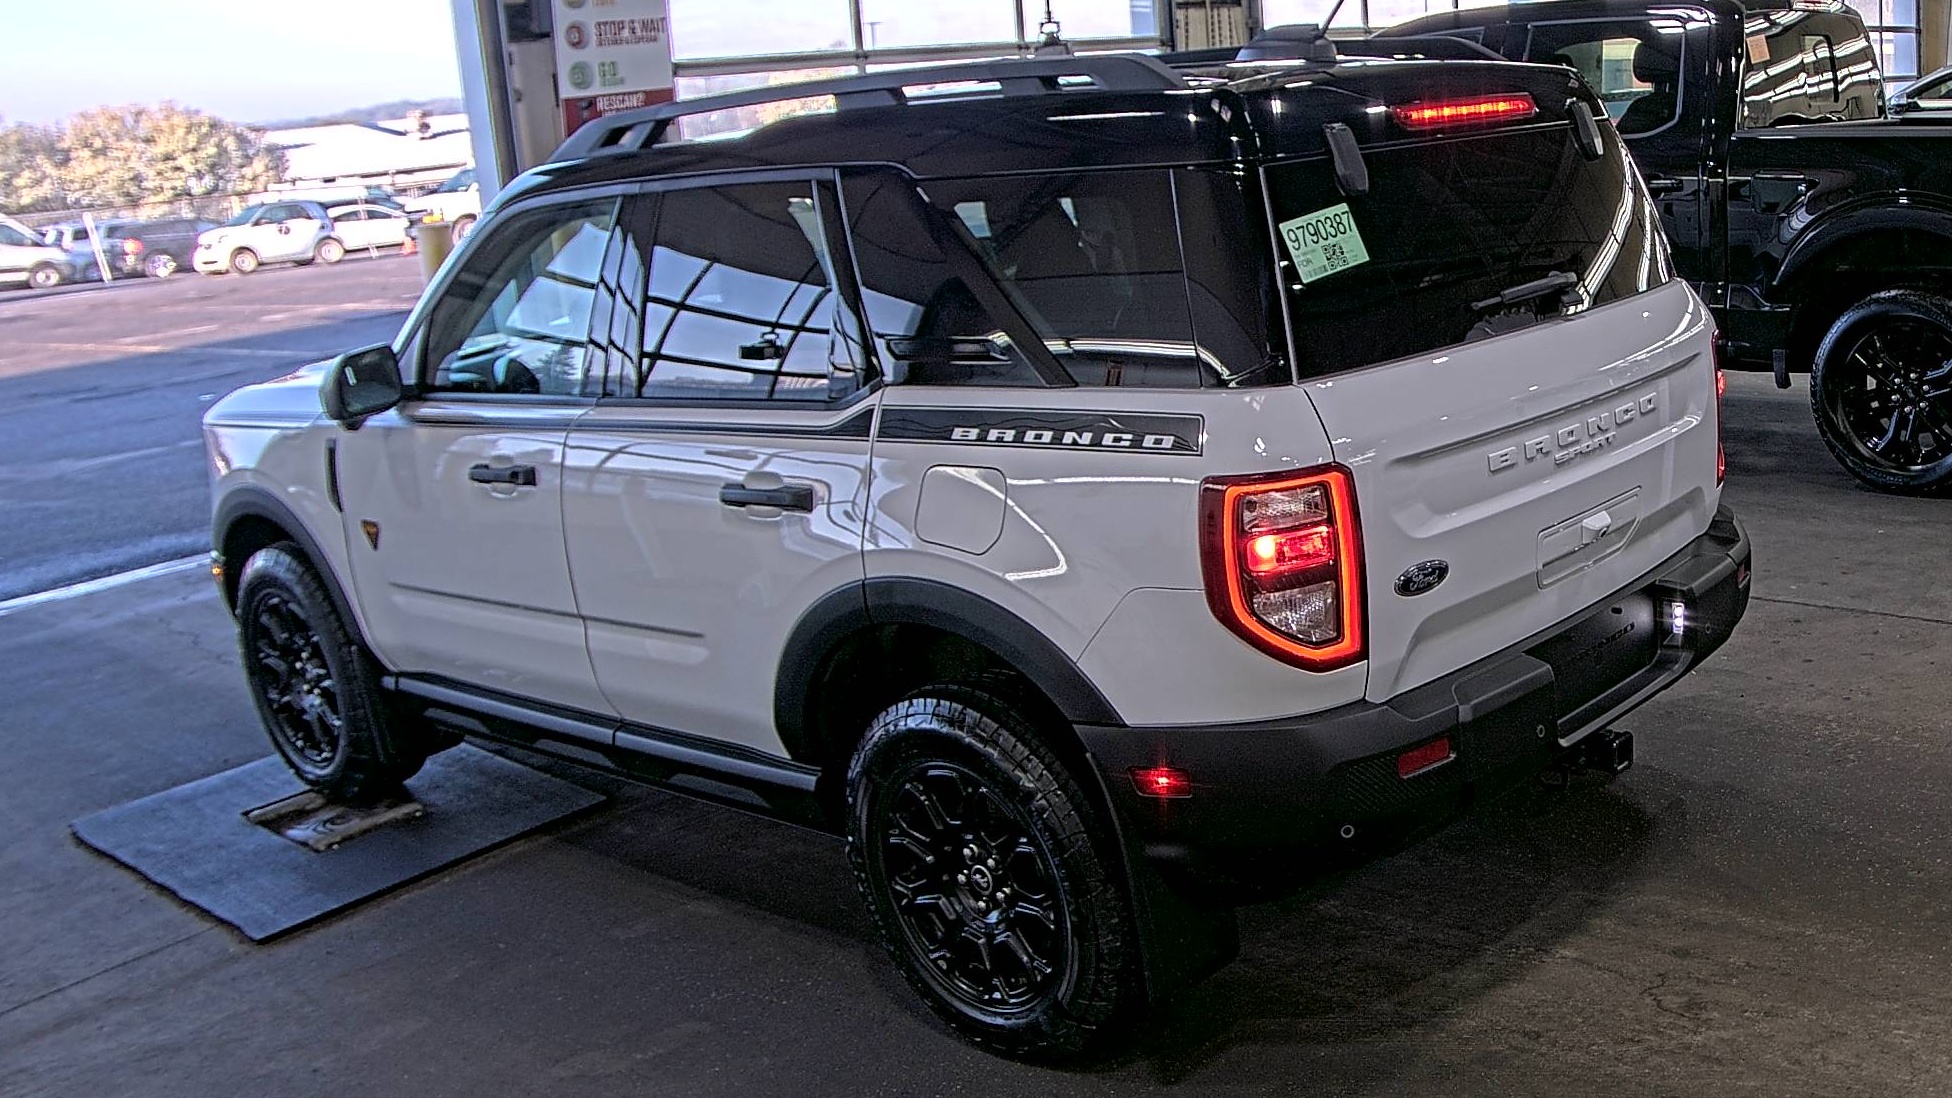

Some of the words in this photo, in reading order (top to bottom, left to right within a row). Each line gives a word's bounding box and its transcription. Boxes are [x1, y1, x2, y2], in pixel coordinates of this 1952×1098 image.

[594, 19, 625, 37] STOP
[640, 16, 666, 34] WAIT
[597, 61, 619, 77] GO
[1286, 210, 1353, 251] 9790387
[950, 426, 1176, 449] BRONCO
[1487, 392, 1658, 473] BRONCO
[1553, 431, 1617, 466] SPORT
